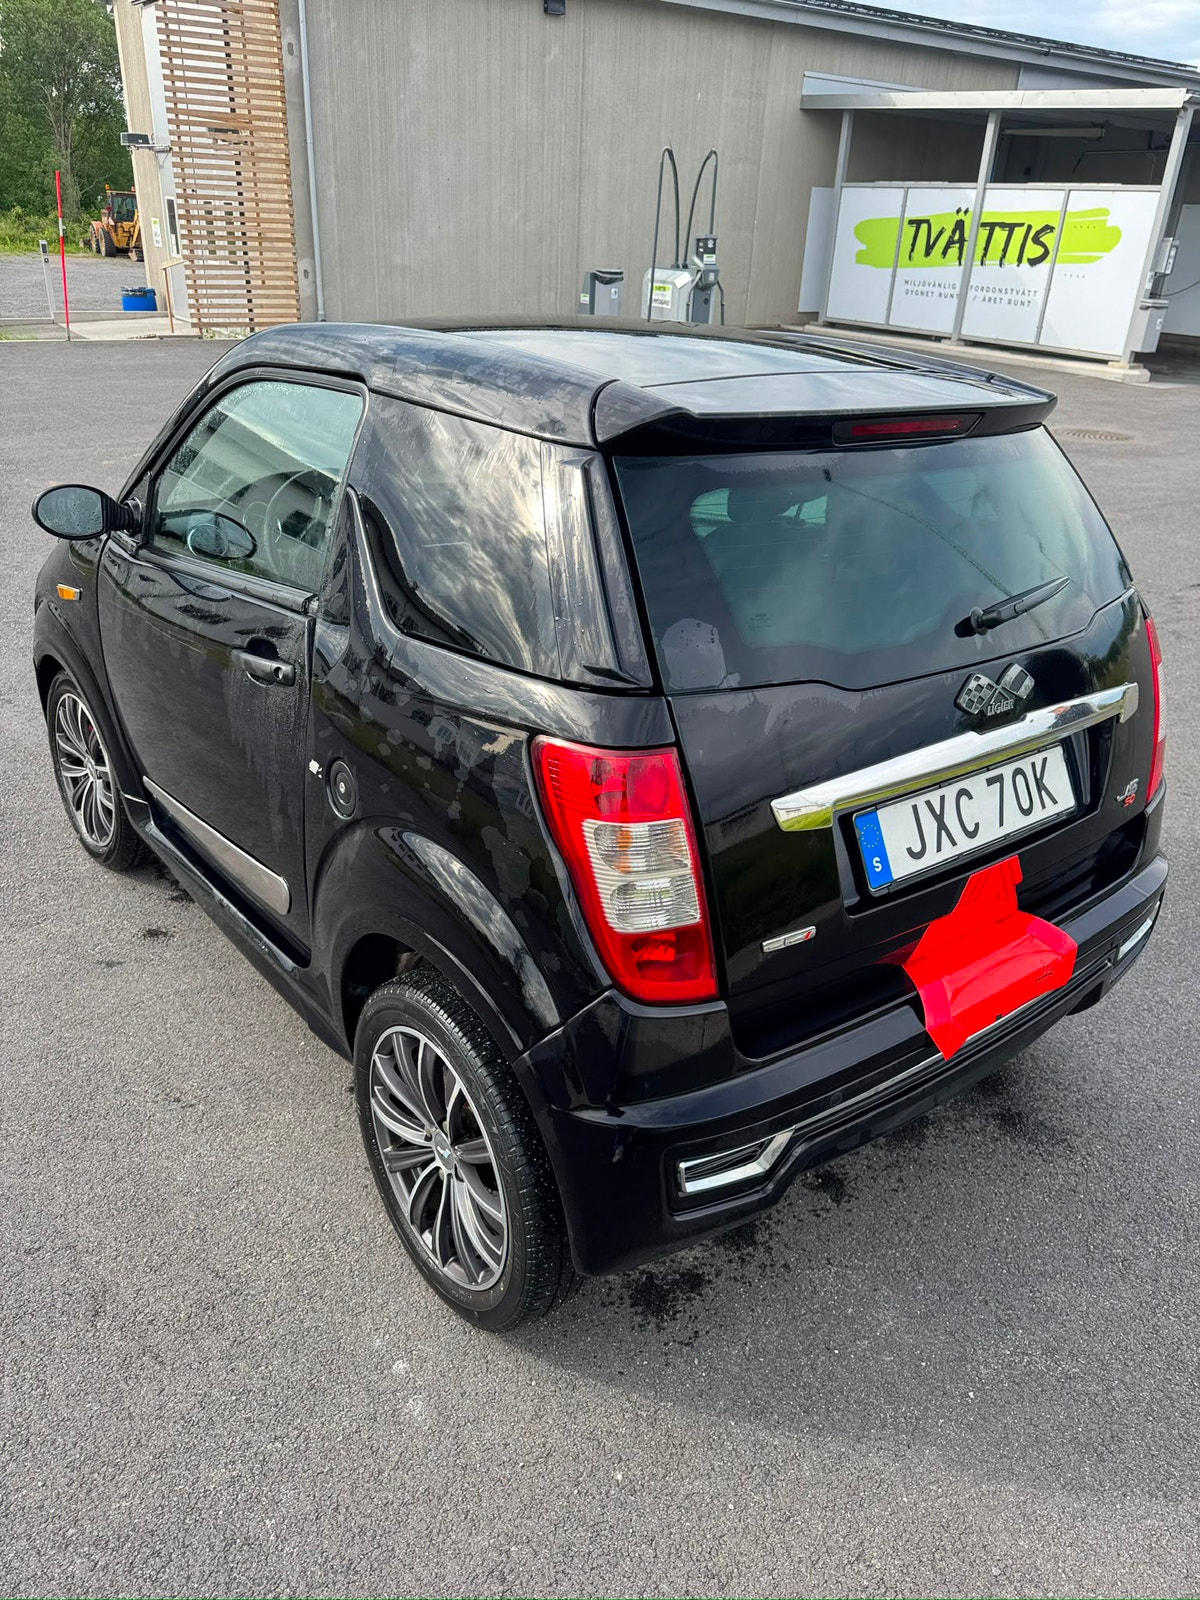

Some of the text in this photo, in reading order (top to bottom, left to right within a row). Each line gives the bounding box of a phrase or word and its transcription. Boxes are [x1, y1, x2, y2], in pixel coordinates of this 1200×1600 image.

[908, 207, 1056, 268] TVÄTTIS
[904, 279, 1038, 297] MILJÖVÄNLIG FORDONSTVÄTT
[905, 289, 934, 297] DYGNET
[938, 292, 960, 300] RUNT
[982, 295, 1003, 304] ÅRET
[1007, 298, 1032, 307] RUNT
[906, 756, 1059, 860] JXC 70K
[872, 857, 882, 872] S
